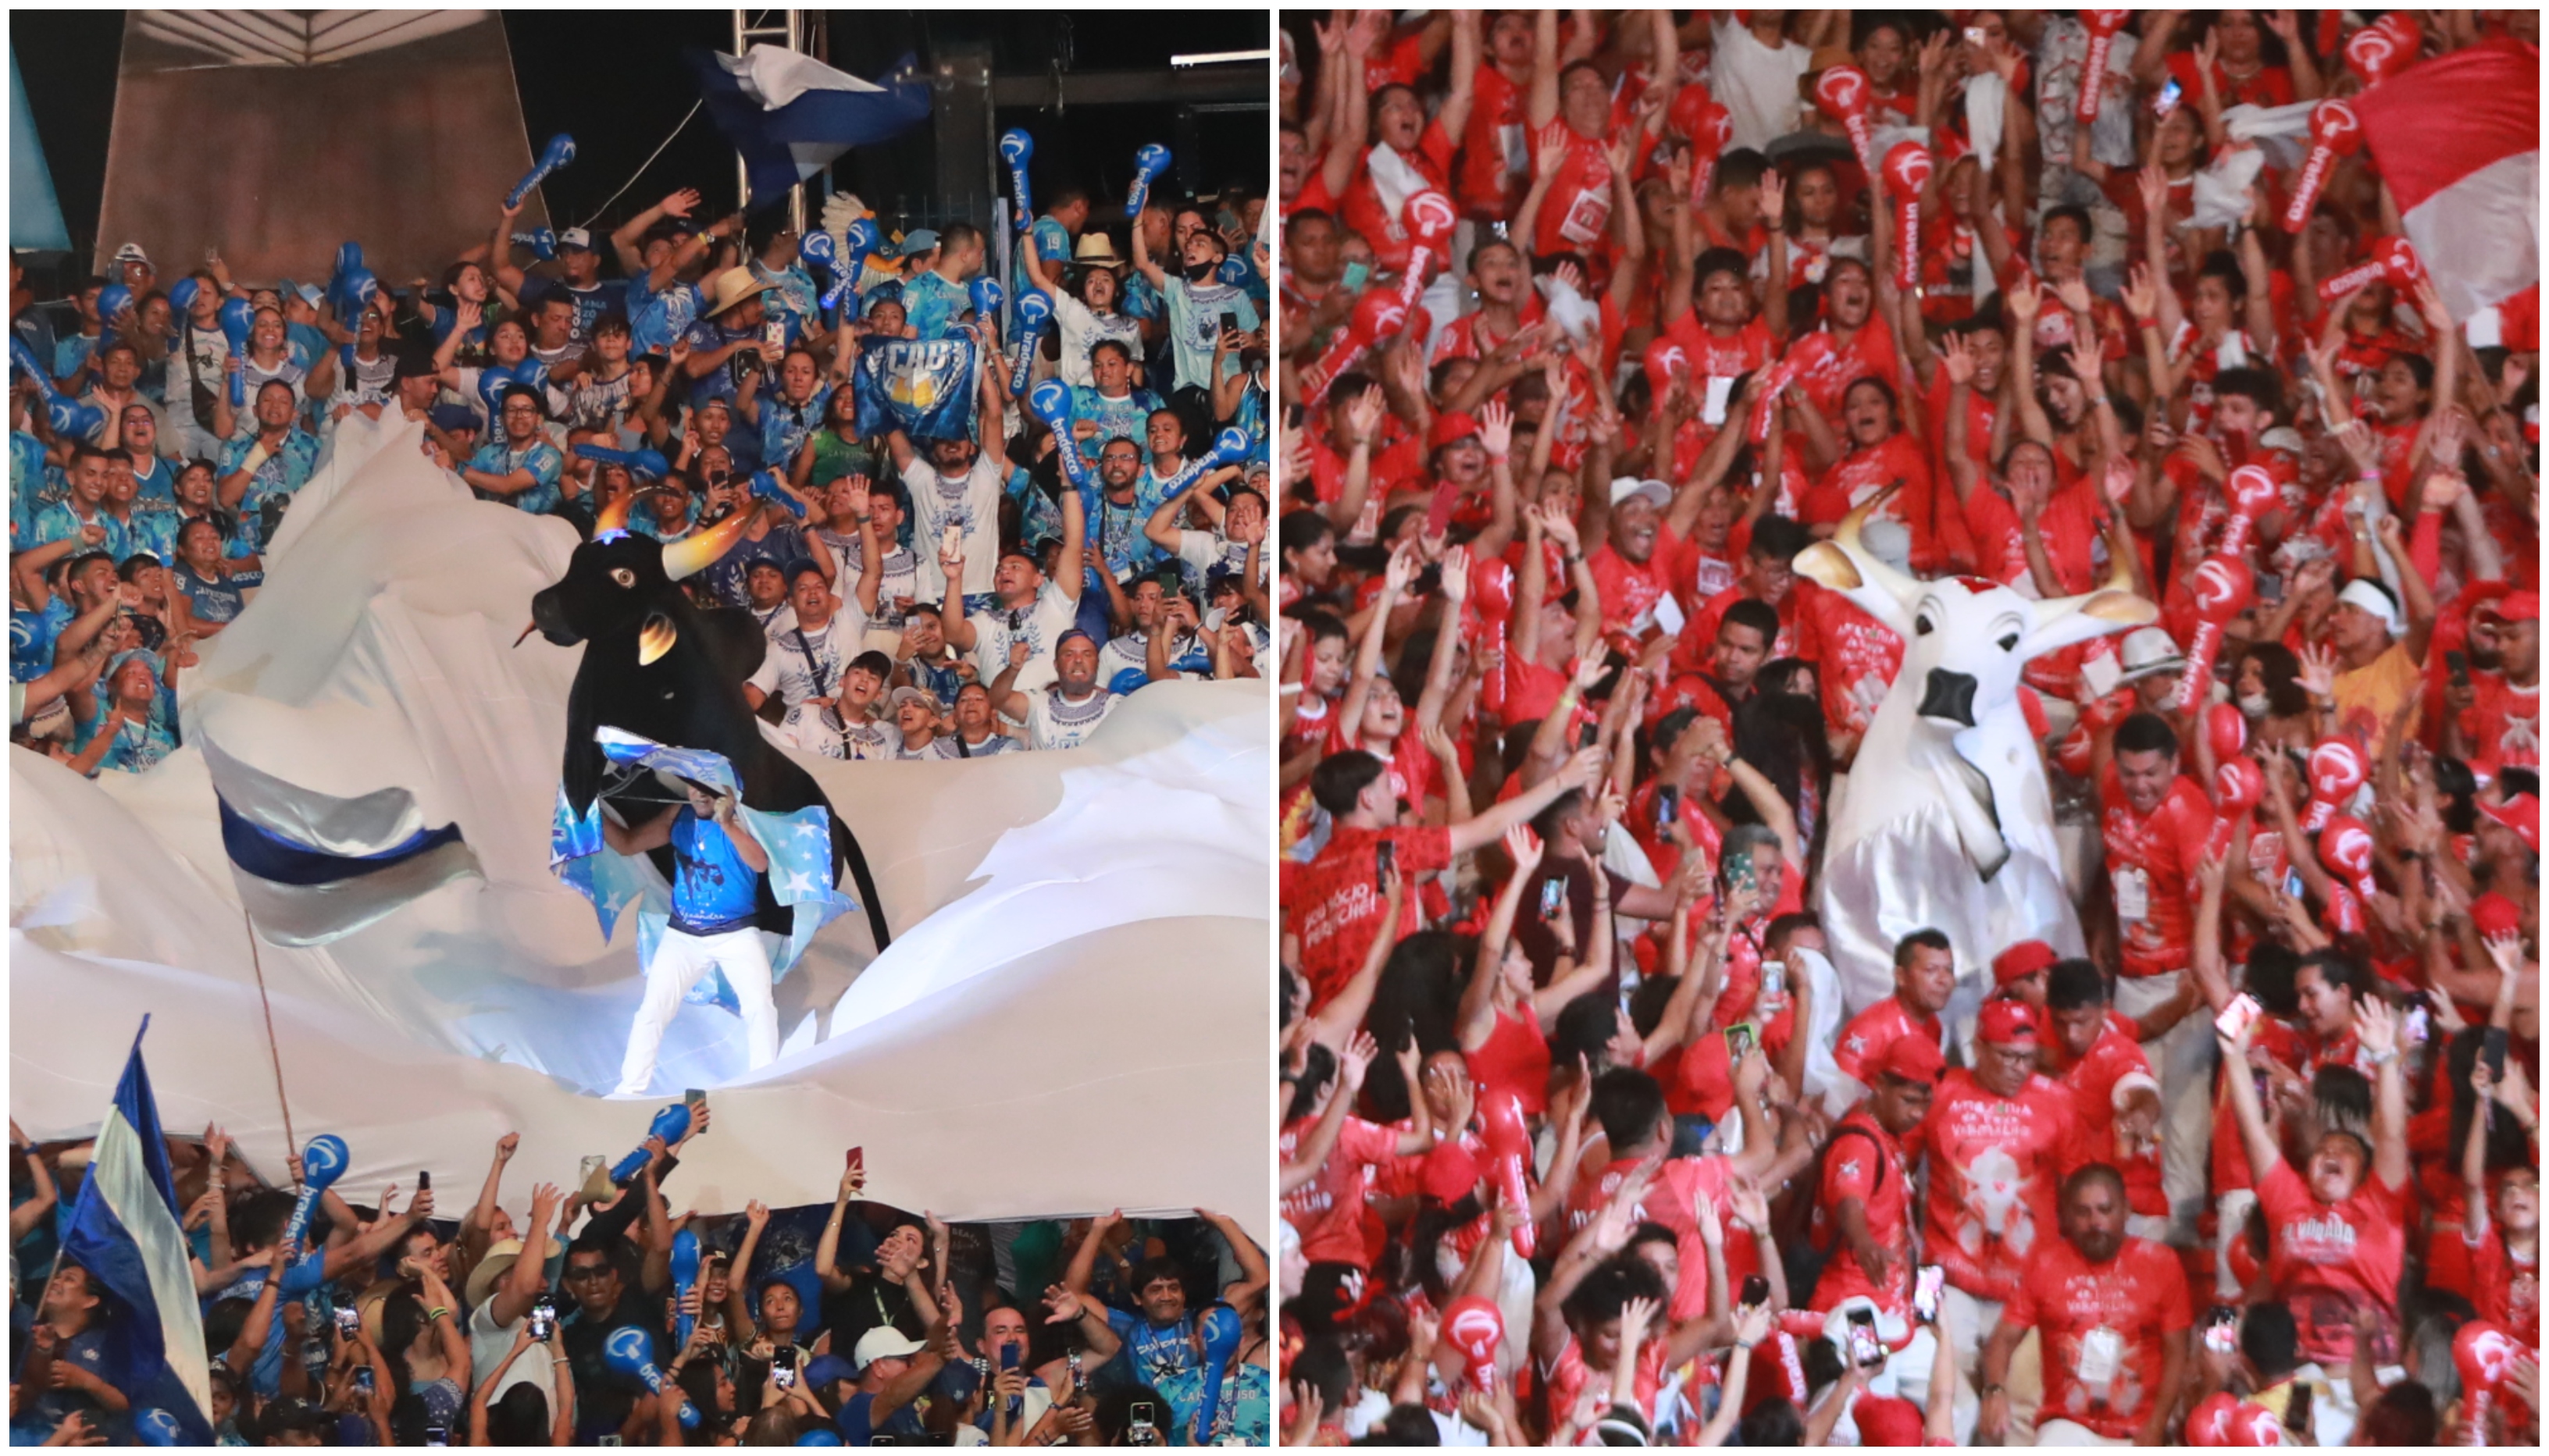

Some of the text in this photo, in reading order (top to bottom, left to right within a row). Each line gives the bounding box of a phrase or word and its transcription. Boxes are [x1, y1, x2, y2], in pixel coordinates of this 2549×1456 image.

[1012, 170, 1027, 208] brade
[1013, 331, 1036, 389] bradesco
[1051, 417, 1078, 475] bradesco
[1168, 450, 1219, 489] bradesco
[286, 1186, 318, 1239] brades
